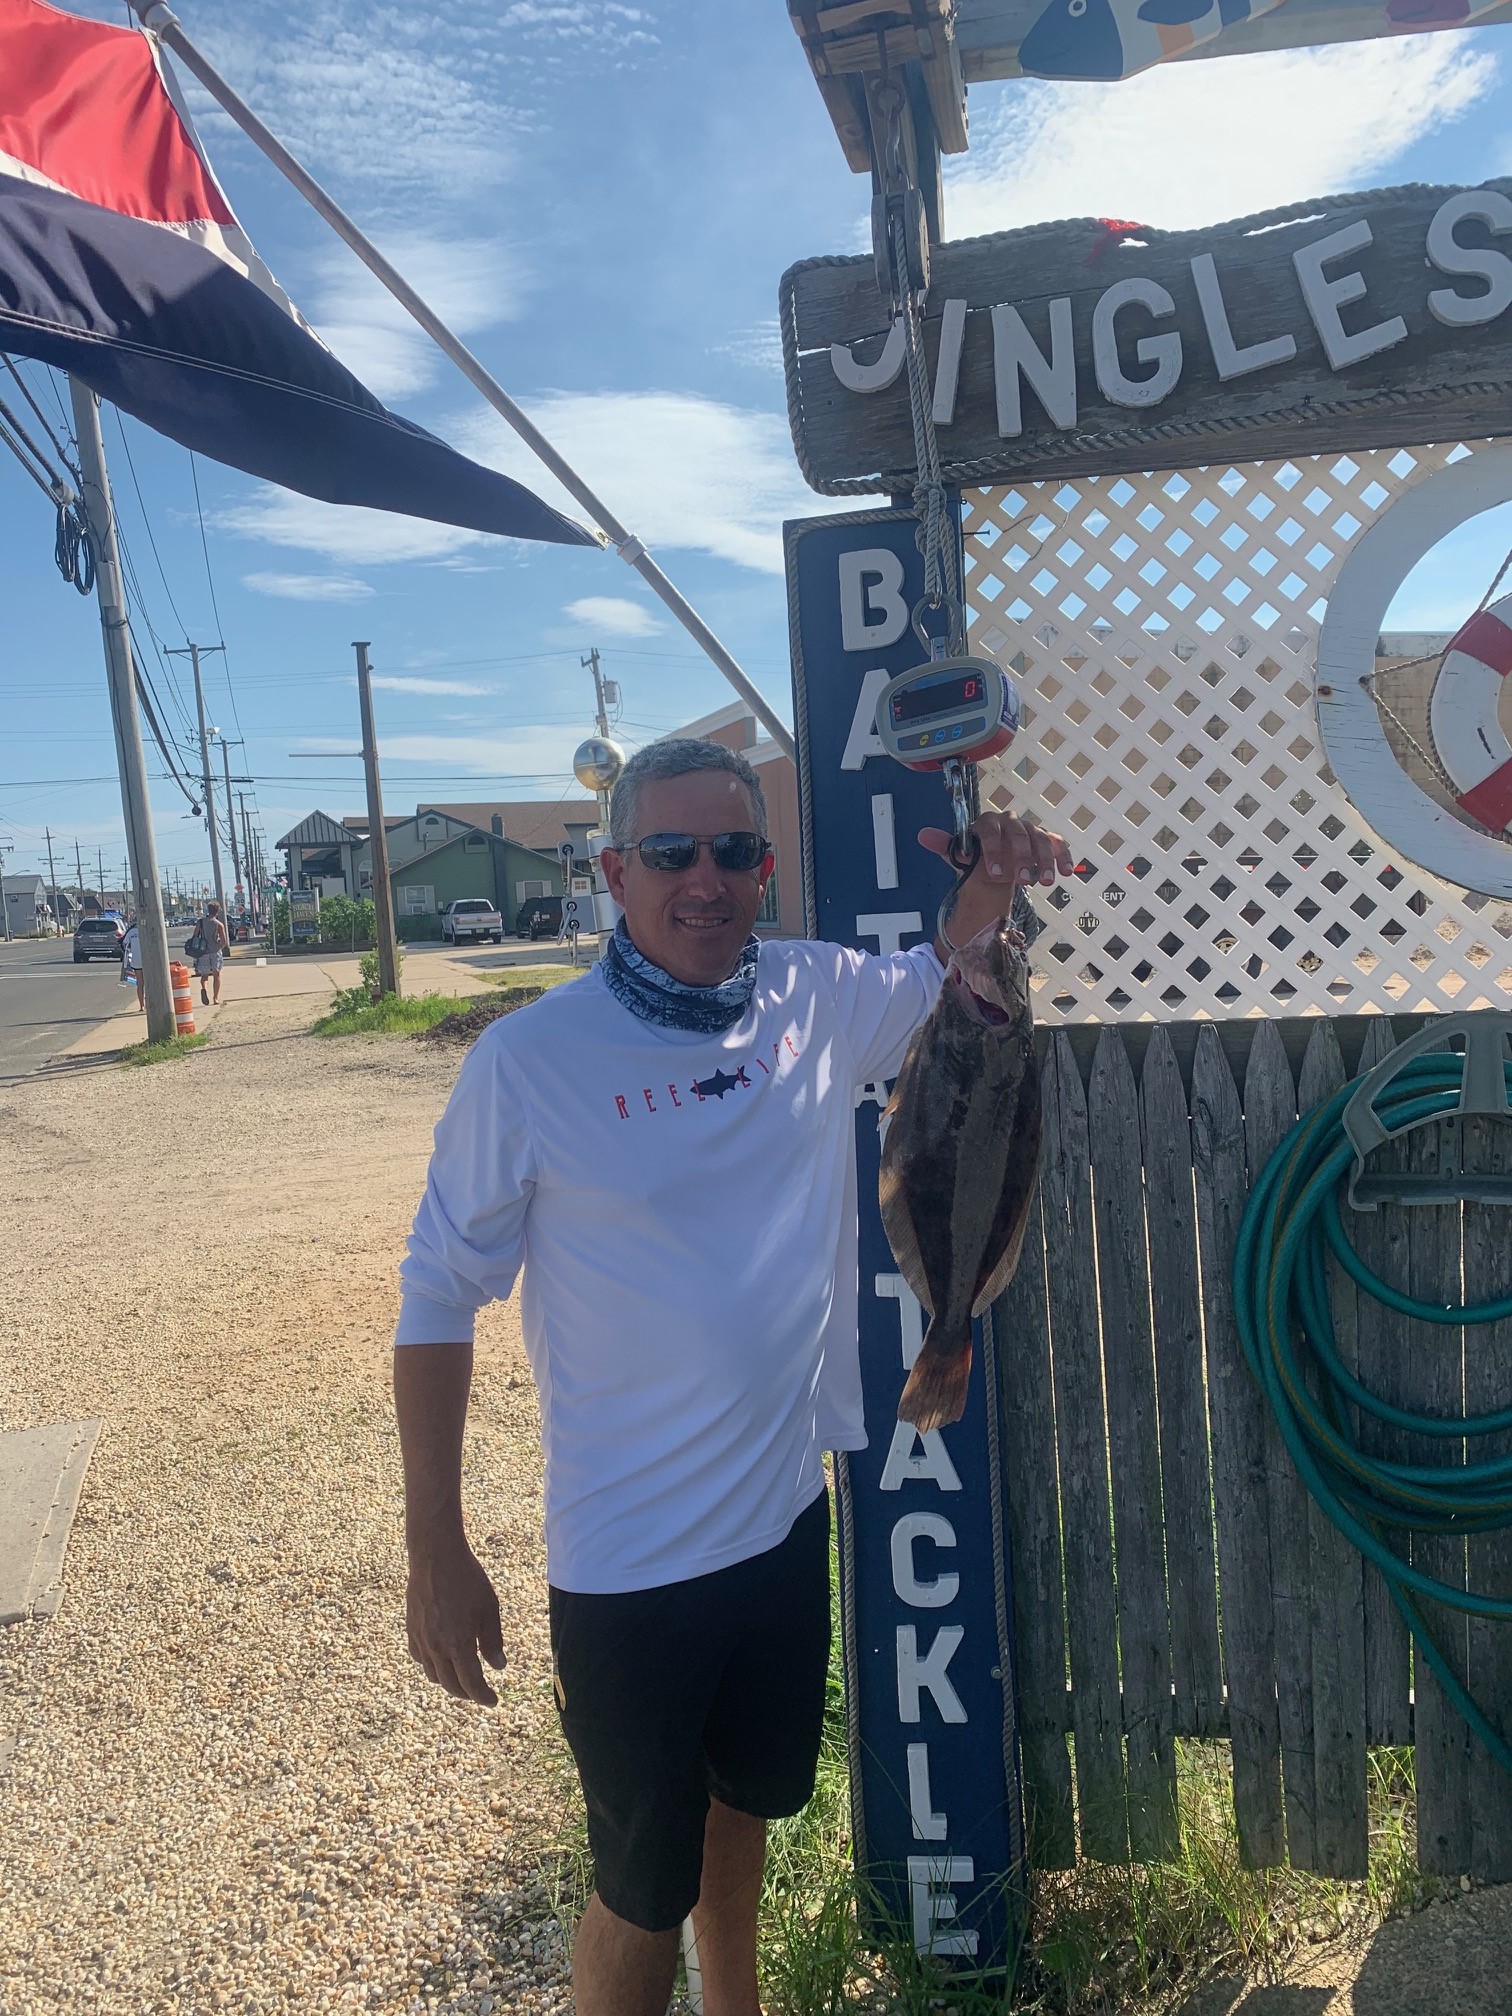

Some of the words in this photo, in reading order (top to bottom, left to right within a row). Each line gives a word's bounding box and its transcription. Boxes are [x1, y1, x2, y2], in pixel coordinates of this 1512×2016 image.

[831, 189, 1512, 438] JINGLES
[965, 681, 976, 698] 0
[614, 1078, 706, 1120] REEL
